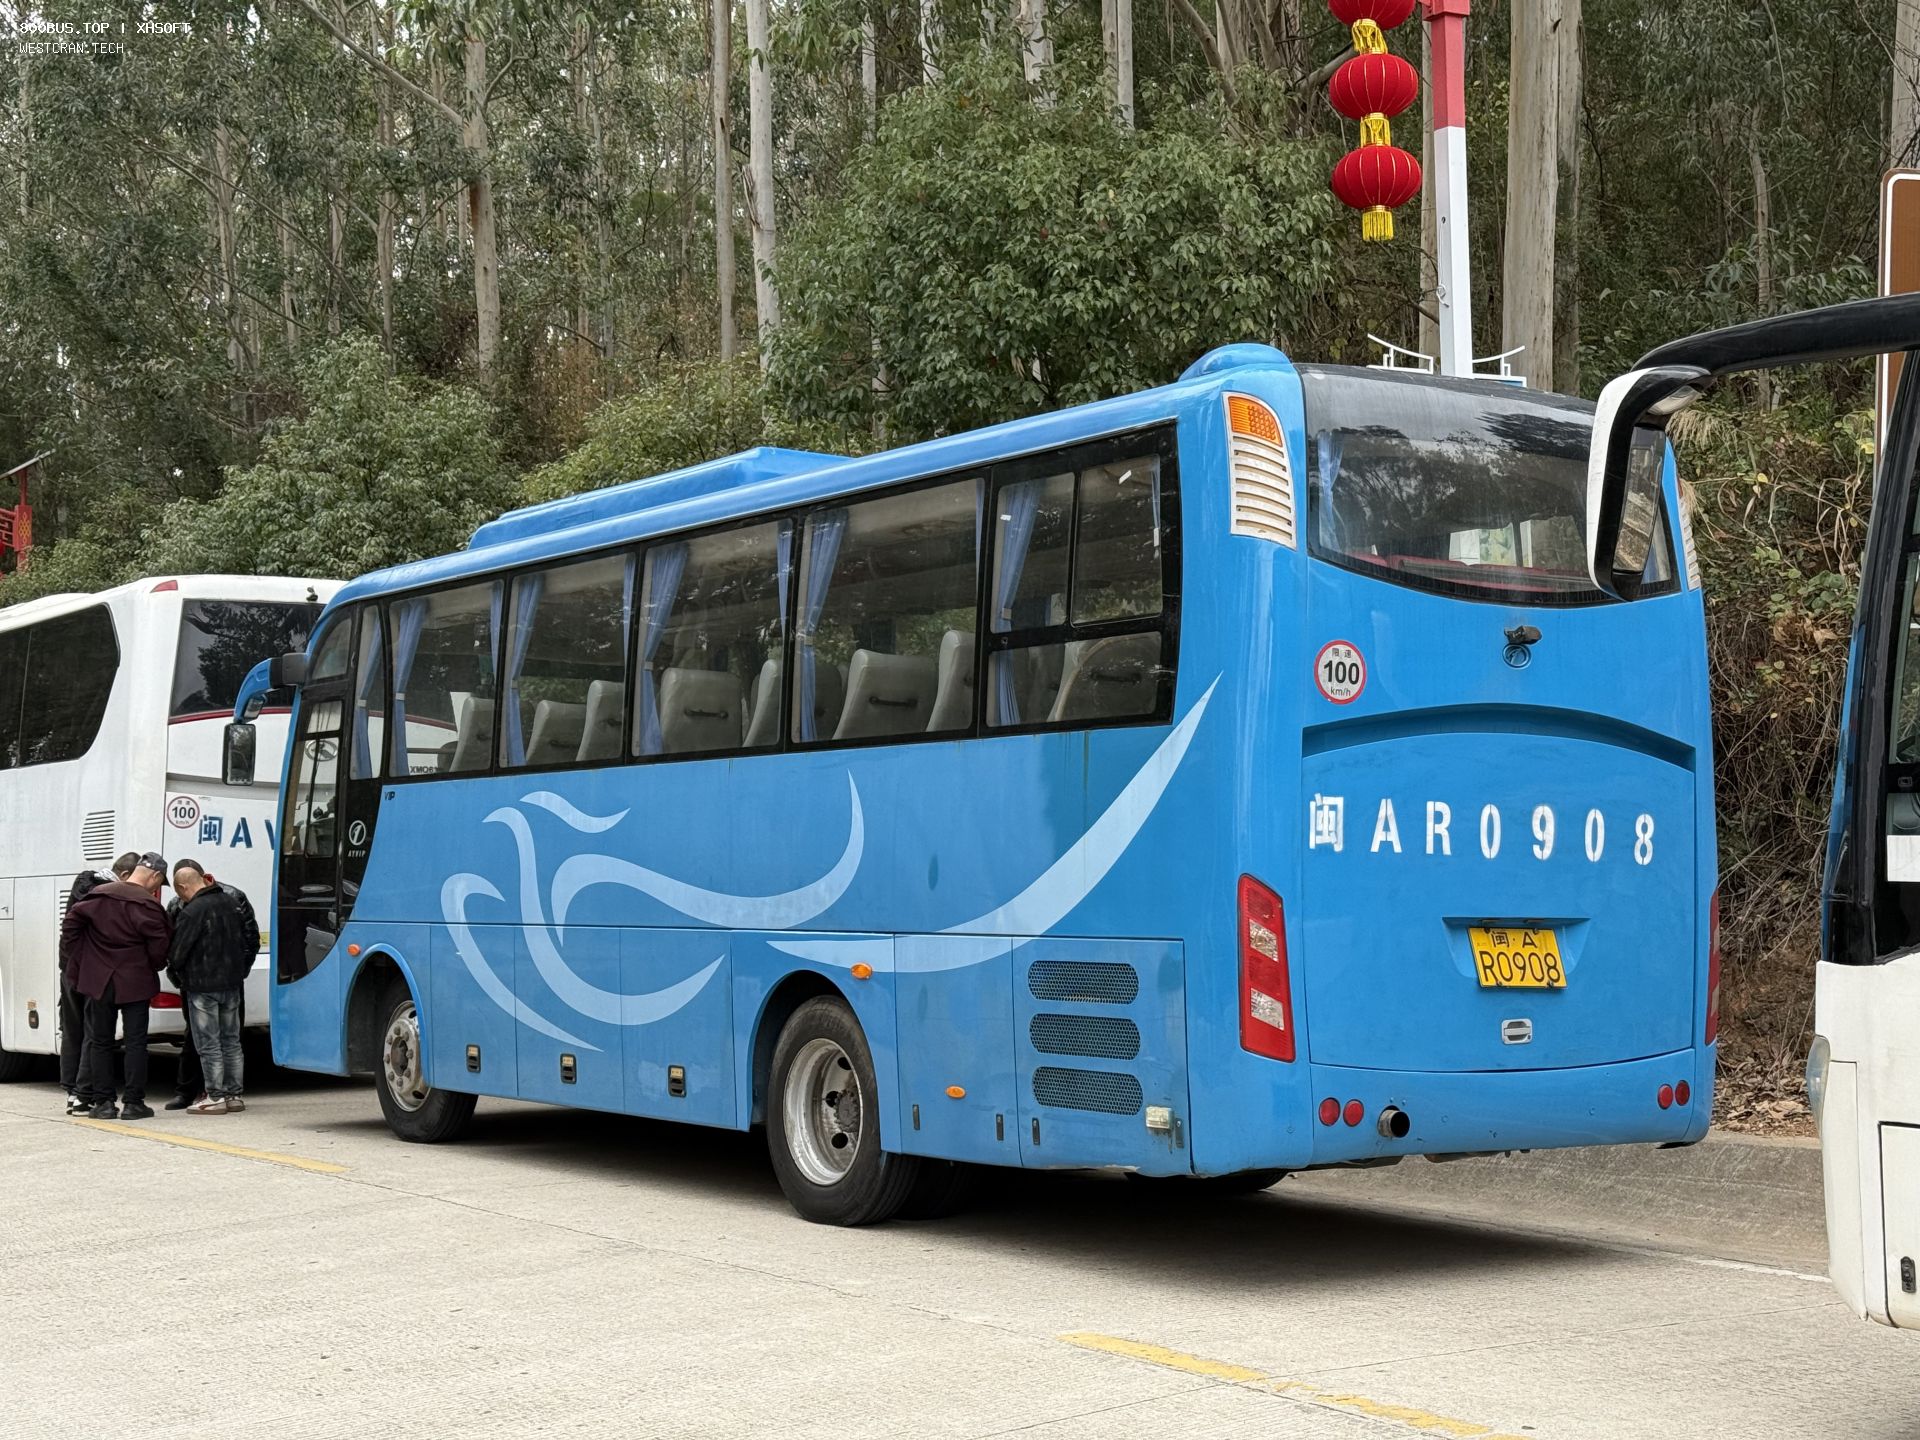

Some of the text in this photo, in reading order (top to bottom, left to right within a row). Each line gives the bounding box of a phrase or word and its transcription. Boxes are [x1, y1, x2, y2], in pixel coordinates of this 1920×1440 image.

[1323, 659, 1360, 685] 100
[1330, 686, 1351, 697] km/h
[171, 806, 196, 819] 100
[1478, 950, 1561, 983] R0908
